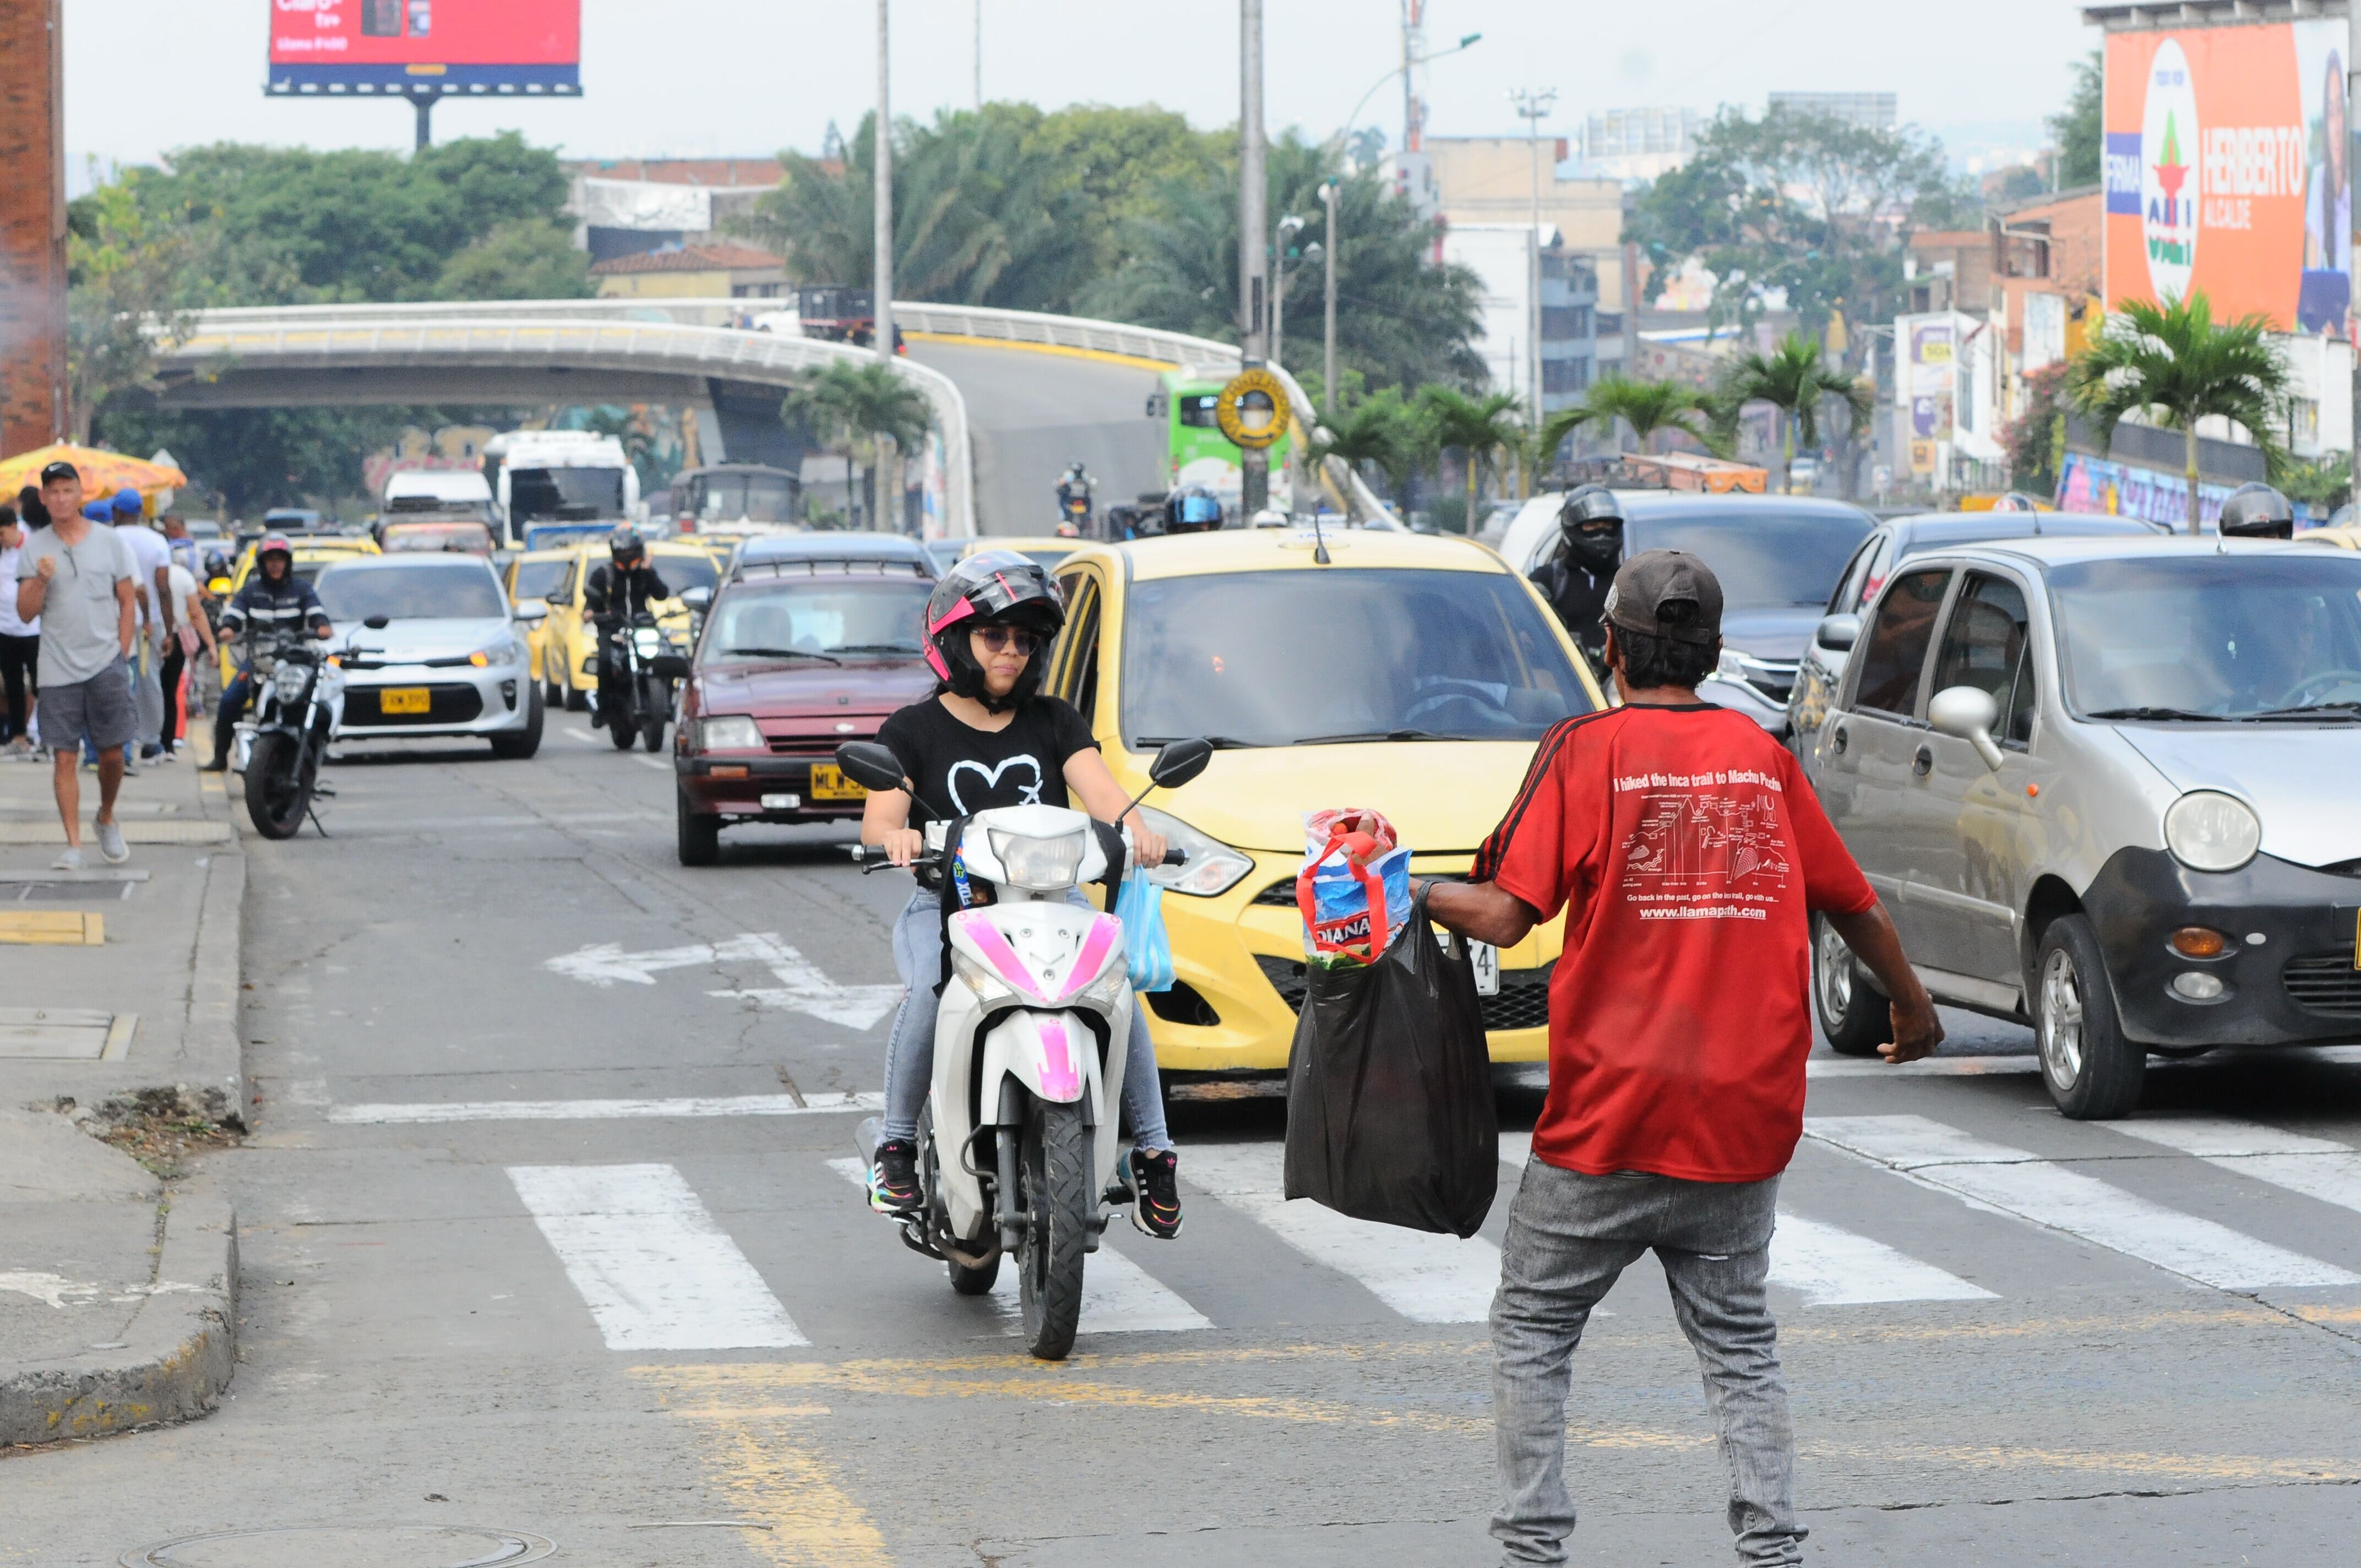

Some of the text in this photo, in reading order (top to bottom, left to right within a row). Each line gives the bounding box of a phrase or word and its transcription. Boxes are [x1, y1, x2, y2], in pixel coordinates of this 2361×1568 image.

[2203, 126, 2304, 197] HERIBERTO
[2204, 199, 2252, 230] ALCALDE
[1613, 777, 1619, 792] I
[1619, 773, 1650, 792] hiked
[1650, 772, 1667, 787] the
[1668, 772, 1690, 787] Inca
[1691, 771, 1714, 787] trail
[1715, 771, 1727, 785] to
[1728, 769, 1760, 785] Machu
[1676, 894, 1691, 902] past,
[1732, 892, 1744, 900] trail,
[1639, 905, 1766, 919] www.llamapath.com
